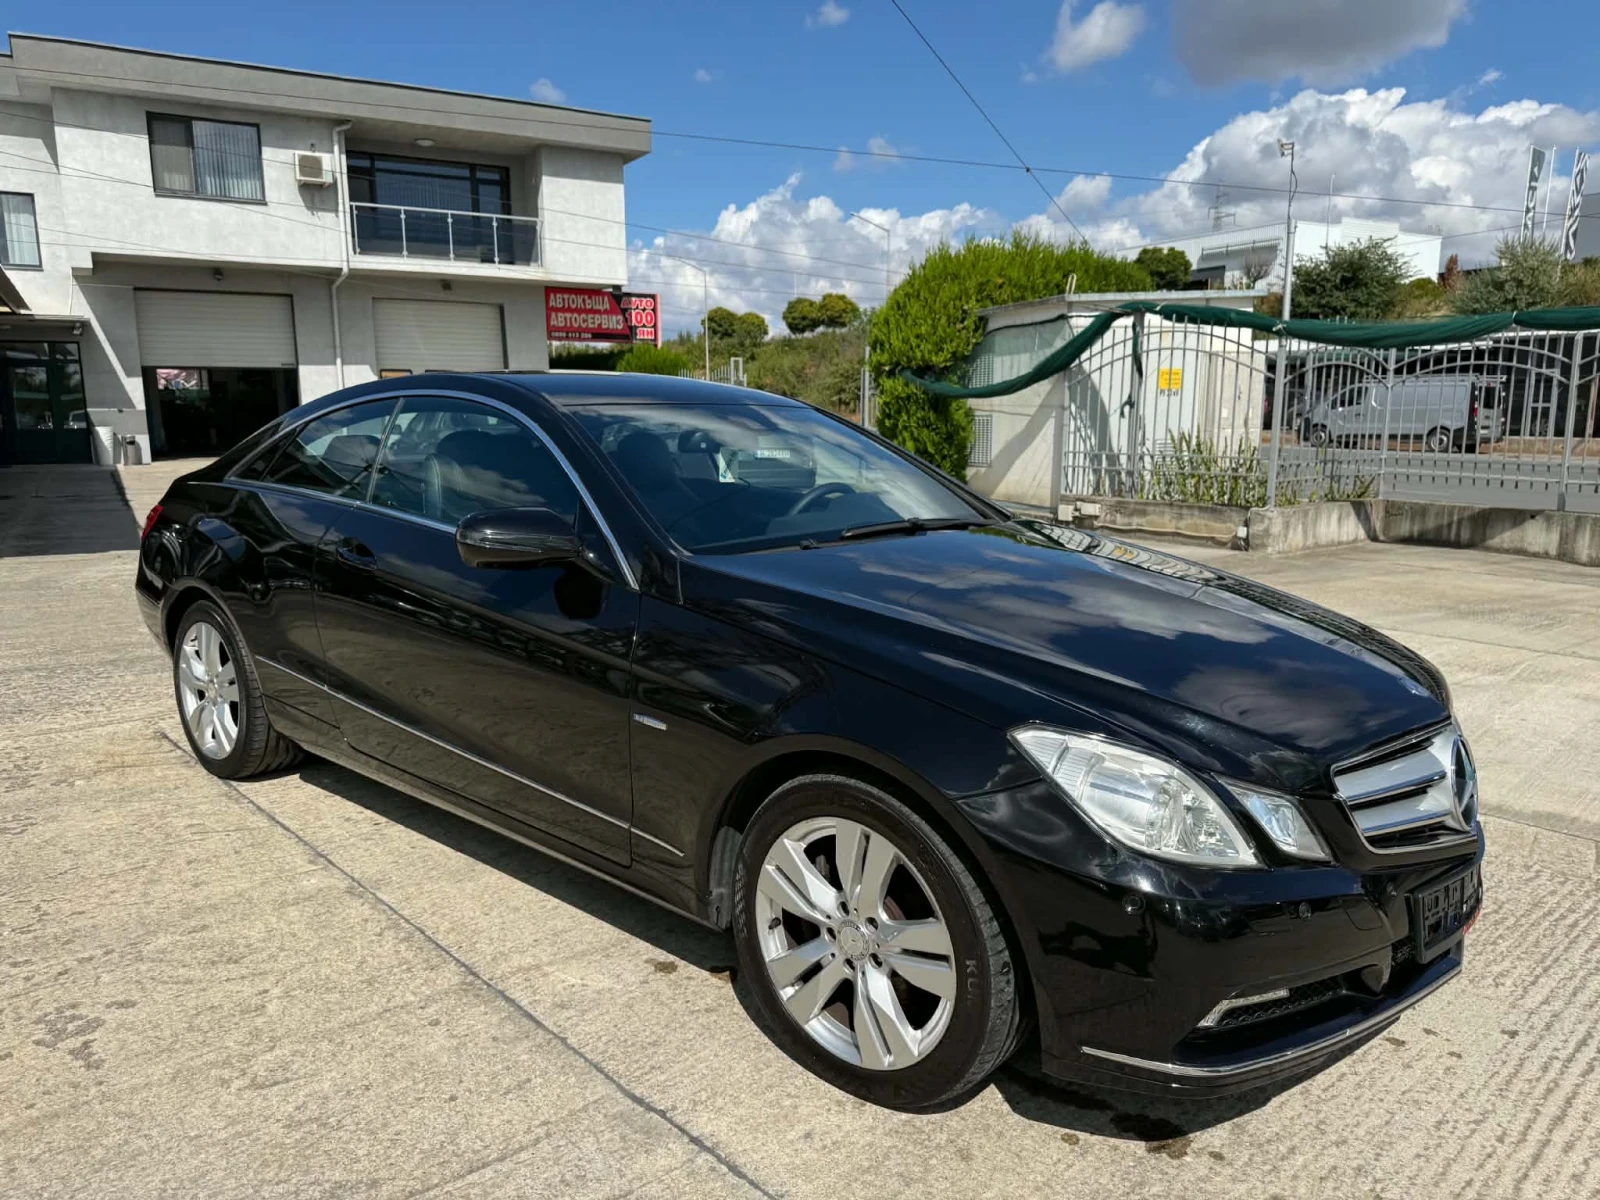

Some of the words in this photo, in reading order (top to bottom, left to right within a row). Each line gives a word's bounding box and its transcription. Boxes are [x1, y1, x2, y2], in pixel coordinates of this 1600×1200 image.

[549, 293, 610, 312] АВТОКЪЩА
[621, 297, 655, 309] АУТО
[550, 312, 624, 330] АВТОСЕРВИЗ
[626, 310, 655, 326] 100
